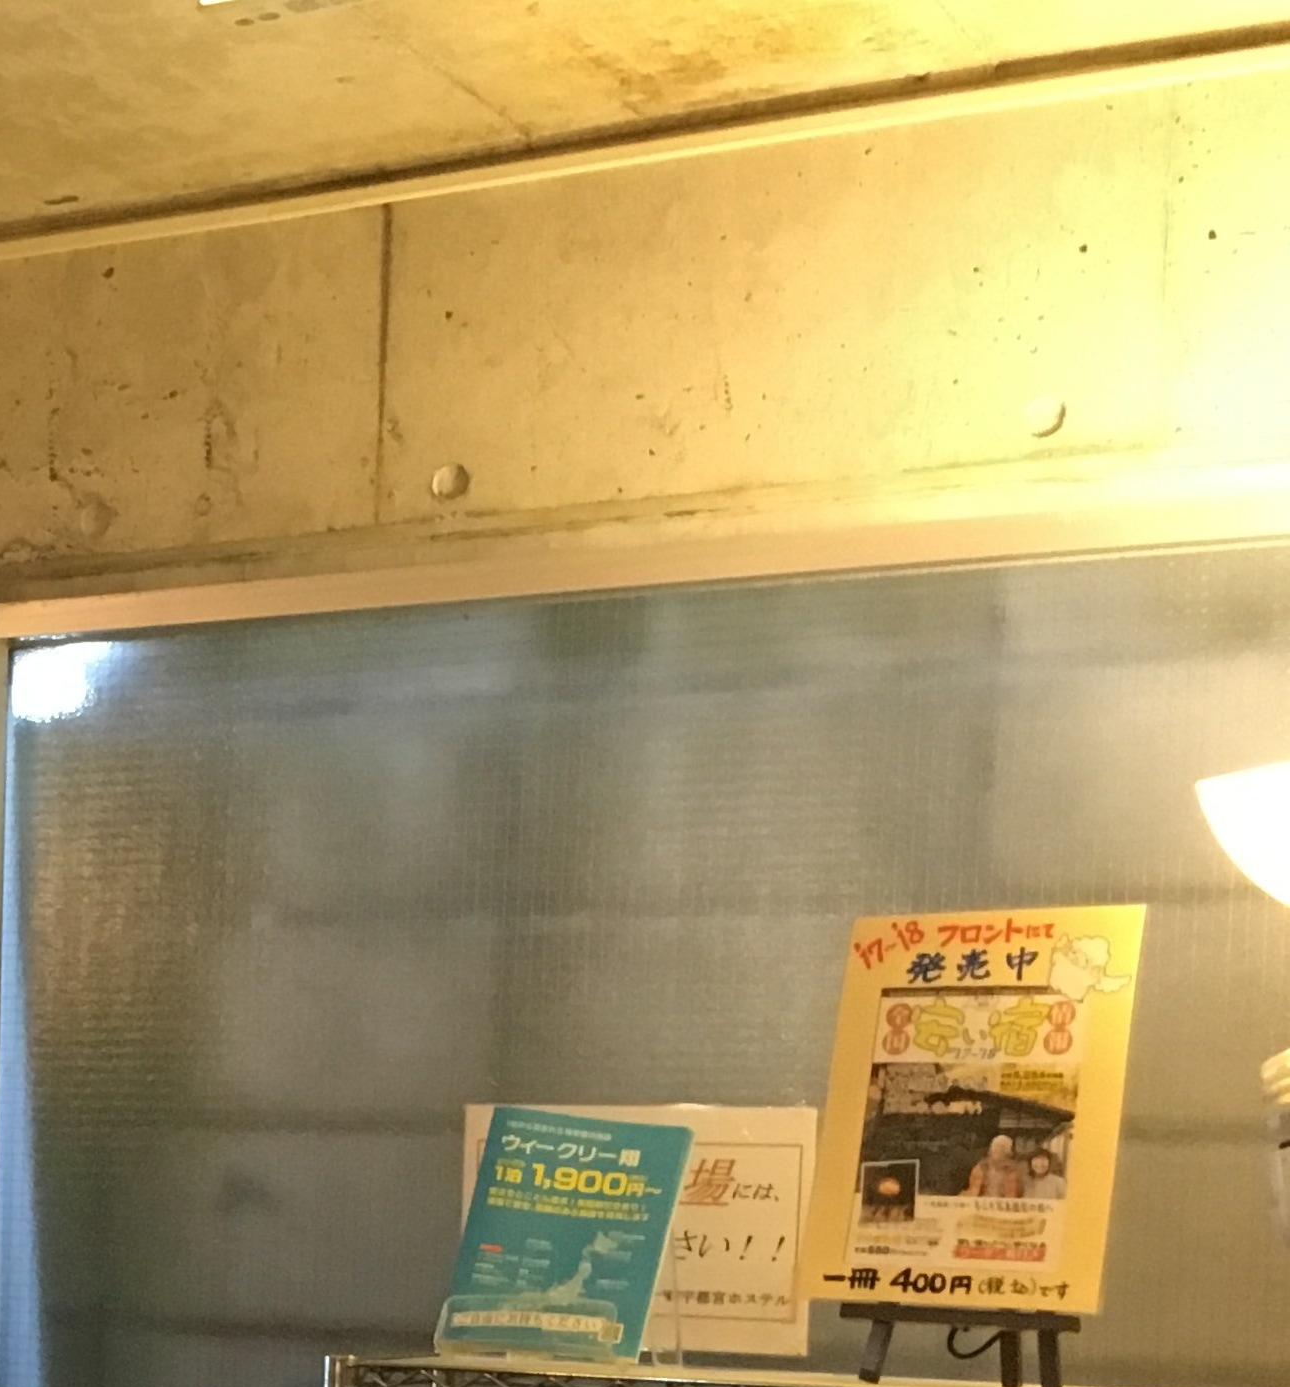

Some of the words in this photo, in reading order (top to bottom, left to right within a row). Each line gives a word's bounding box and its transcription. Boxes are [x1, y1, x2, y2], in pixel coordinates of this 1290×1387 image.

[937, 917, 1055, 948] フロントにて
